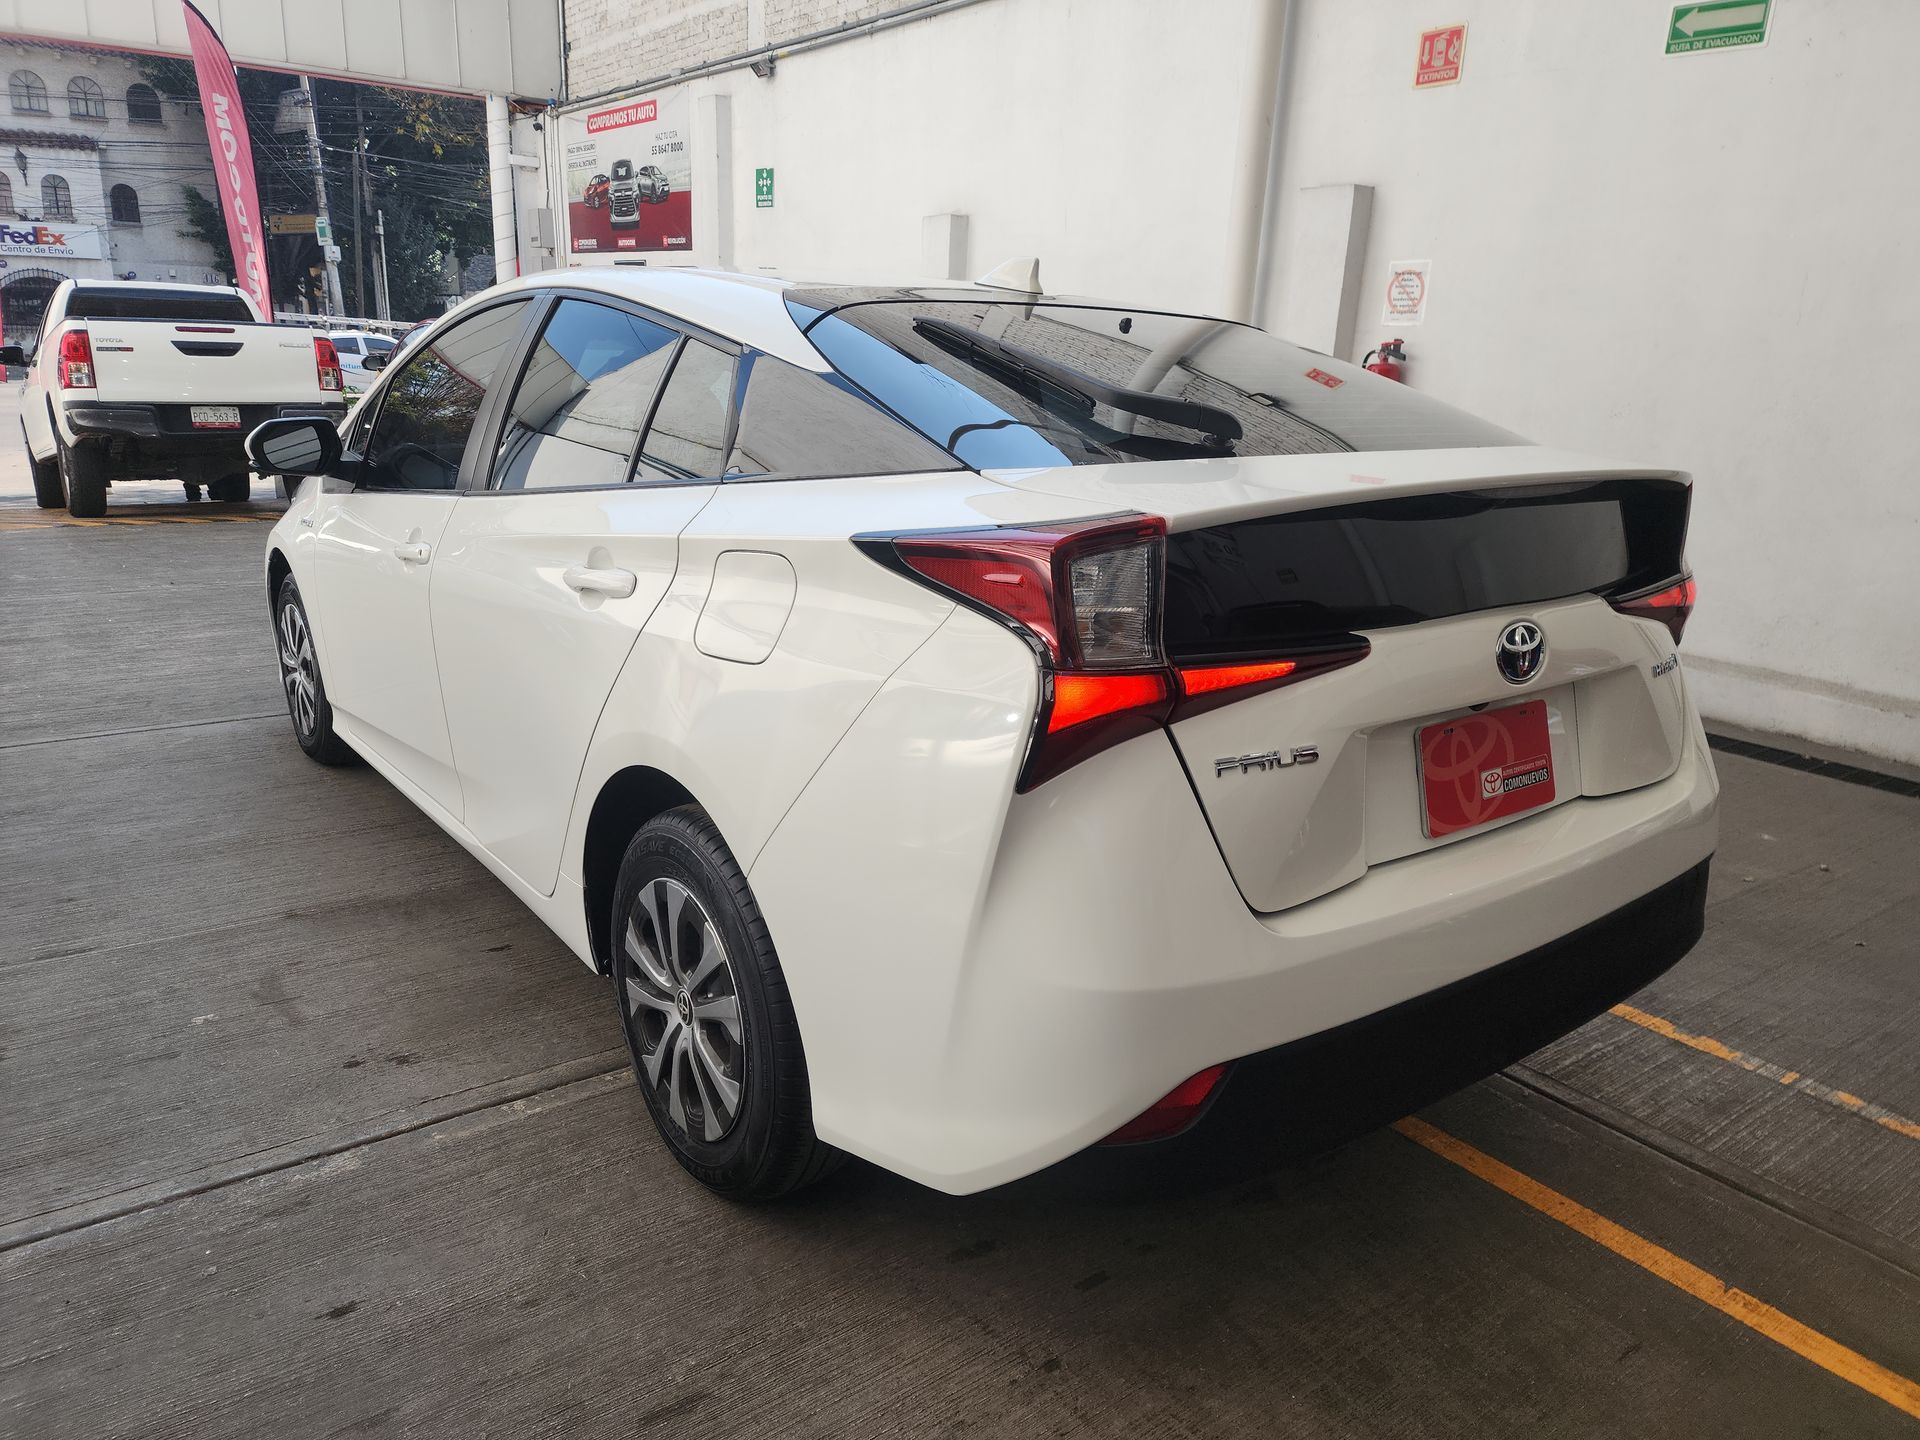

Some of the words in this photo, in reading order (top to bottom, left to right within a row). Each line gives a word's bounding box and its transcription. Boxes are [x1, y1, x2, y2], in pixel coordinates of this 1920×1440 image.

[1669, 42, 1691, 53] RUTA
[1693, 41, 1705, 50] DE
[1419, 69, 1456, 82] EXTINTOR
[588, 110, 628, 131] COMPRAMOS
[628, 108, 637, 123] TU
[637, 104, 655, 120] AUTO
[651, 145, 658, 156] 55
[0, 224, 67, 246] FedEx
[0, 245, 32, 253] Centro
[1214, 744, 1320, 778] PRIUS
[1503, 768, 1549, 791] COMONUEVOS
